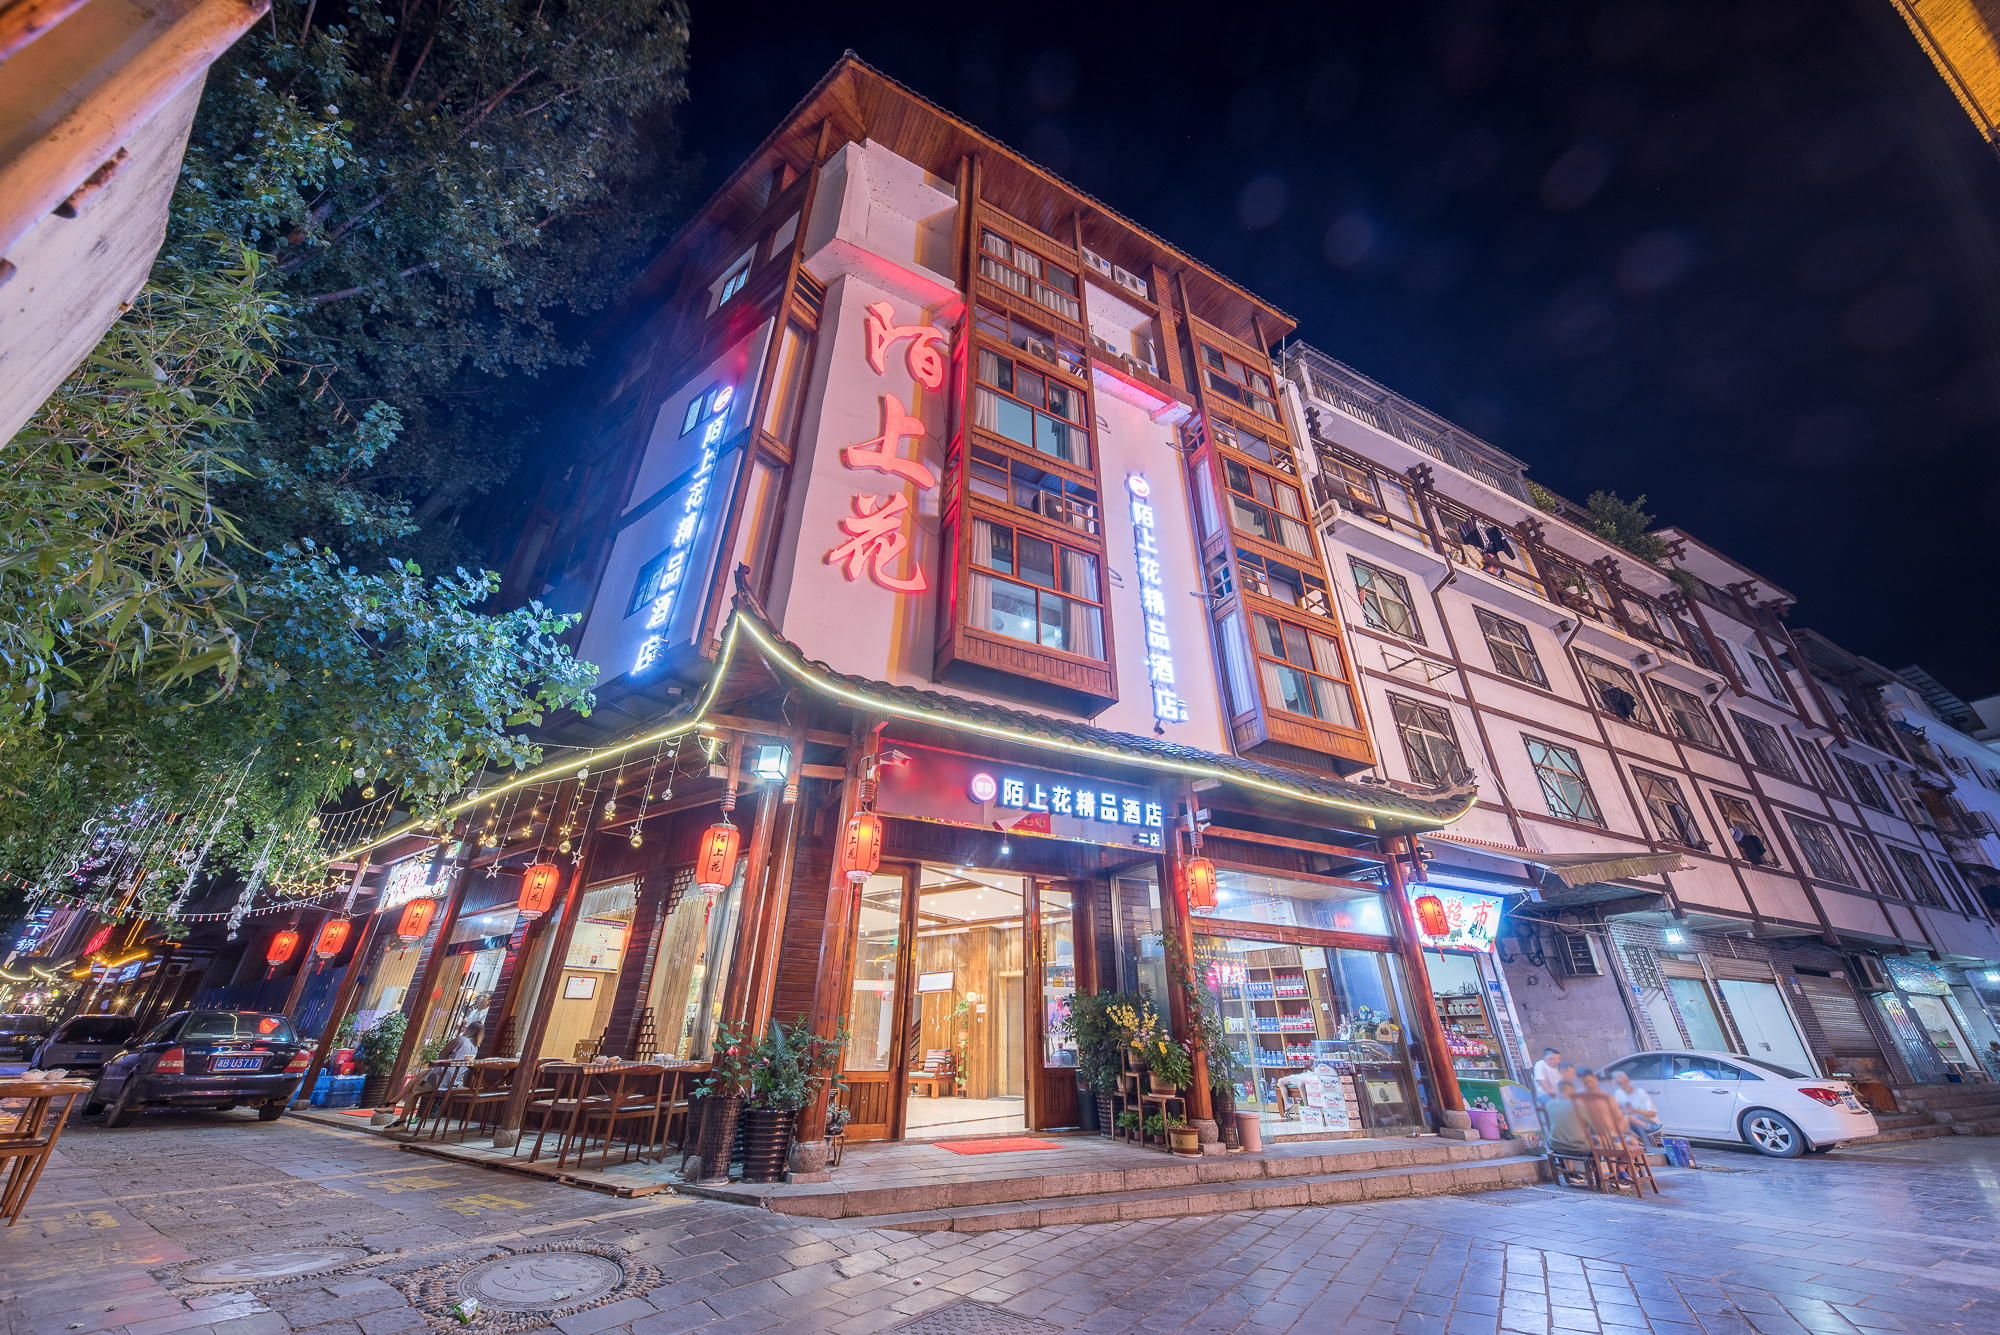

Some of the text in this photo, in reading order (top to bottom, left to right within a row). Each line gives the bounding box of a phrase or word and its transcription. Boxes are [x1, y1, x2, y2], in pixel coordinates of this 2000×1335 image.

[829, 301, 944, 593] 陌上花
[632, 407, 729, 675] 陌上花精品酒店
[1133, 502, 1179, 721] 陌上花精品酒店
[1177, 699, 1188, 721] 二店
[1003, 778, 1163, 828] 陌上花精品酒店
[710, 833, 726, 873] 陌上花
[846, 823, 858, 861] 陌上花
[872, 823, 881, 862] 陌上花
[1138, 832, 1160, 847] 二店
[530, 871, 546, 902] 陌上花
